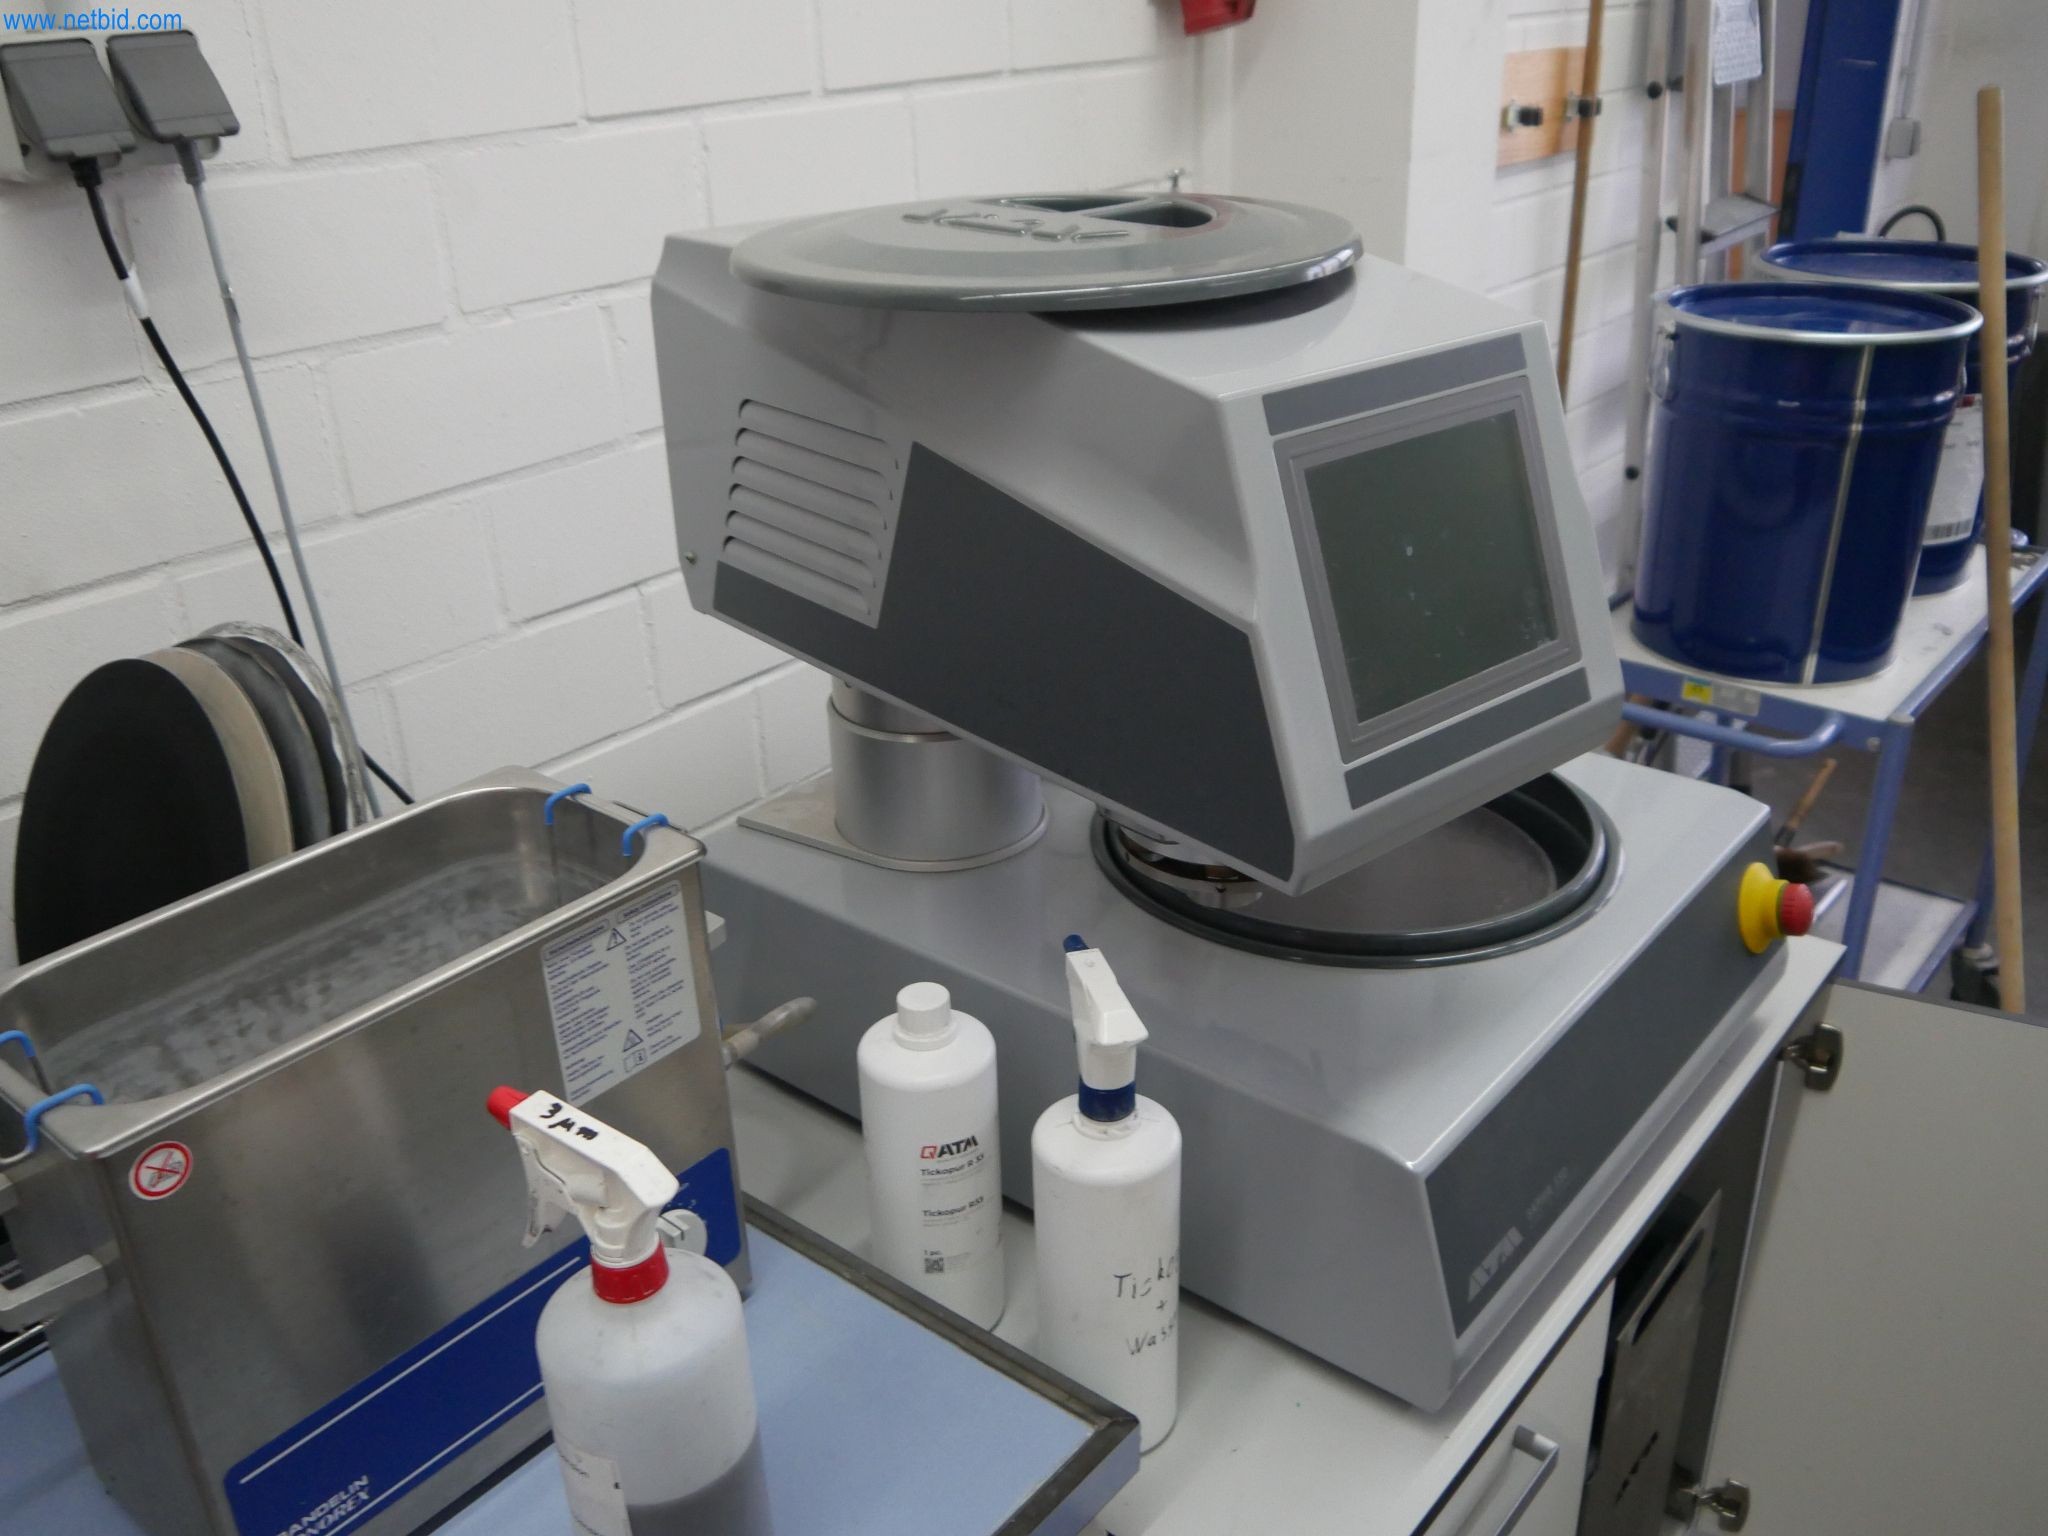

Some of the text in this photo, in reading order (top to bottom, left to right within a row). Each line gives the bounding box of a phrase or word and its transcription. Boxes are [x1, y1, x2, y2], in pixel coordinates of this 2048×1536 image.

[539, 1103, 563, 1119] 3
[920, 1135, 979, 1160] QATM
[276, 1474, 369, 1536] ANDELIN
